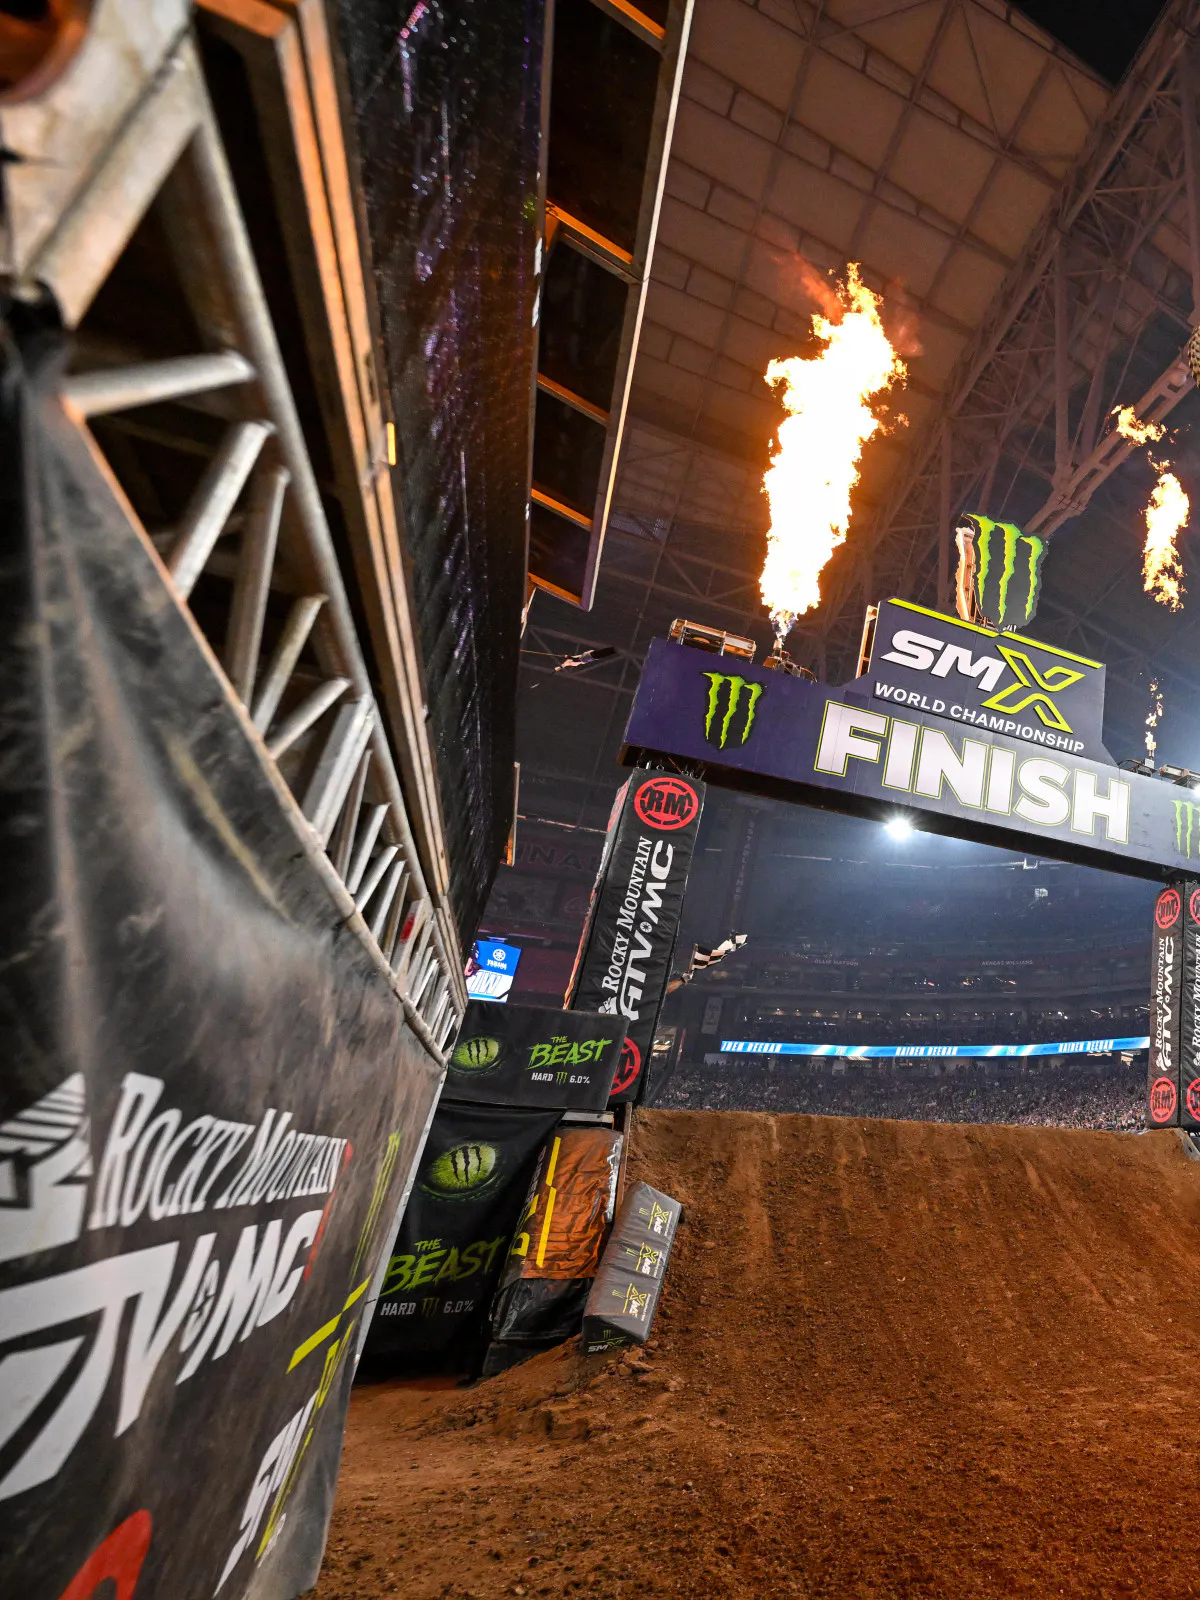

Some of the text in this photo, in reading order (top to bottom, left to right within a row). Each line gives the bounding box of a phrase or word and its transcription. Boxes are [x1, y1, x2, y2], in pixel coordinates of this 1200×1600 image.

[880, 629, 1086, 734] SMX
[874, 682, 1085, 753] WORLD CHAMPIONSHIP
[813, 700, 1131, 845] FINISH
[616, 836, 653, 931] MOUNTAIN
[601, 931, 630, 993] ROCKY
[1156, 937, 1166, 1005] MOUNTAIN
[524, 1039, 613, 1071] BEAST
[551, 1035, 569, 1044] THE
[1155, 1006, 1164, 1048] ROCKY
[531, 1072, 591, 1084] HARD 6.0%
[87, 1072, 348, 1231] ROCKY MOUNTAIN
[380, 1235, 507, 1297] BEAST
[414, 1238, 443, 1252] THE
[380, 1300, 475, 1316] HARD 6.0%
